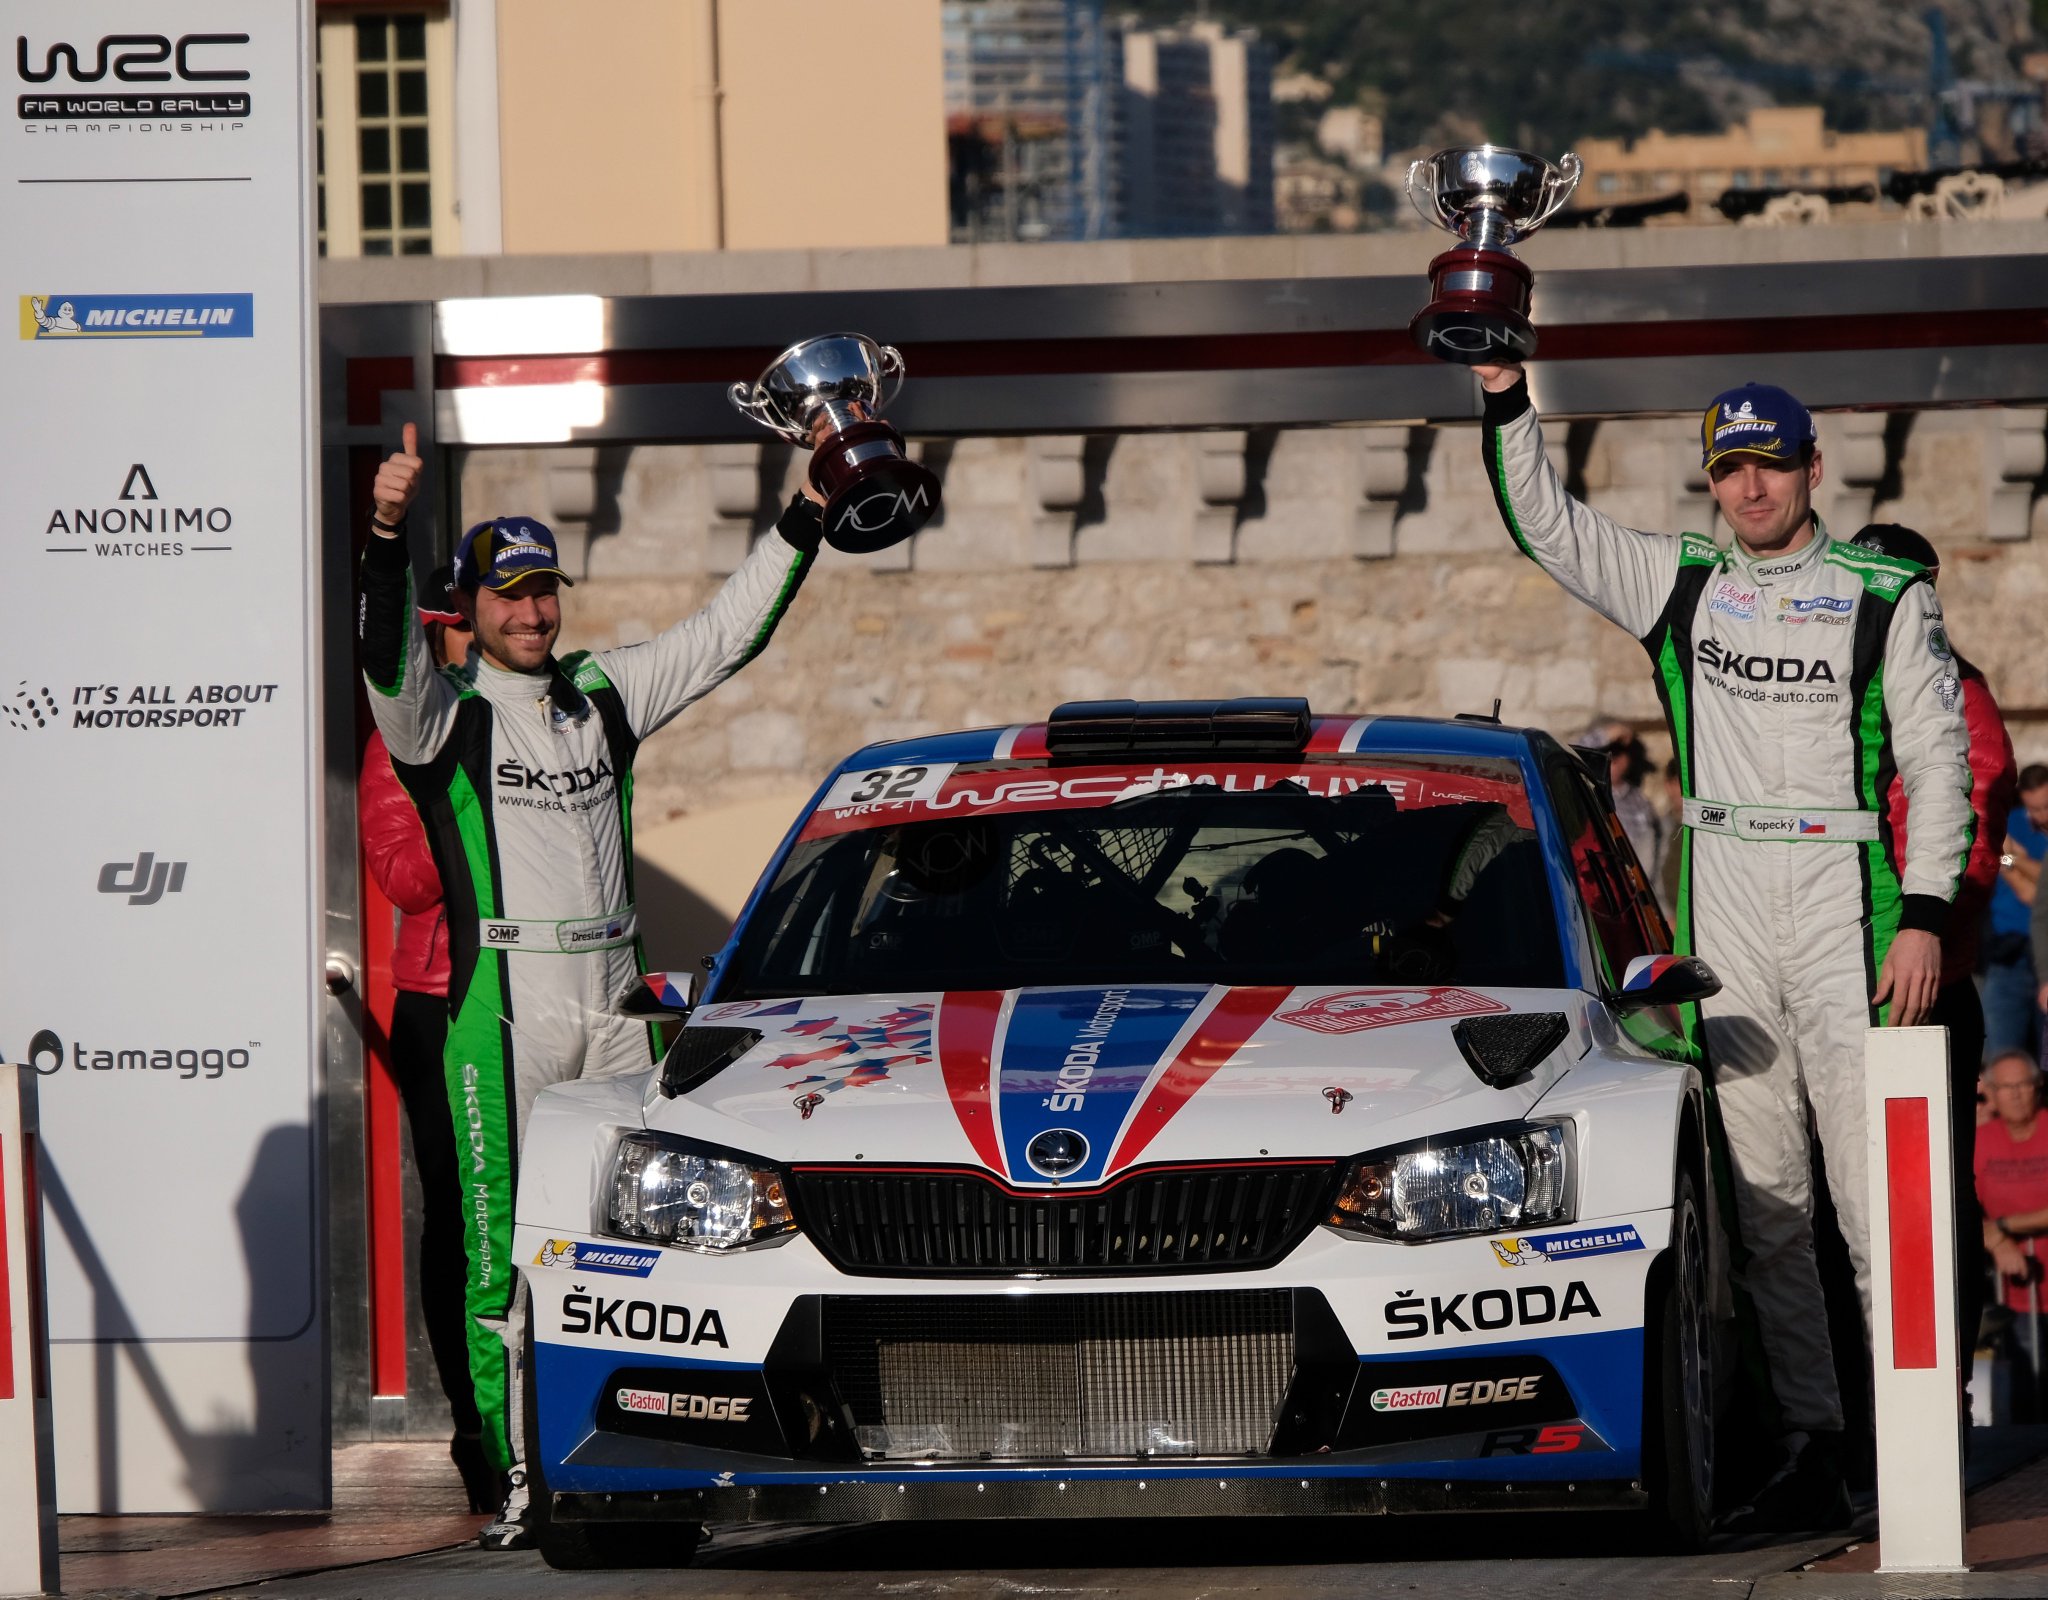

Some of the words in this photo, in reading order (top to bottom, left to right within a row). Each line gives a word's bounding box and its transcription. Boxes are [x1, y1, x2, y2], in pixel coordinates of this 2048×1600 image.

[17, 33, 251, 83] WRC
[24, 101, 59, 113] FIA
[66, 100, 153, 113] WORLD
[160, 99, 244, 112] RALLY
[24, 122, 244, 133] CHAMPIONSHIP
[85, 308, 234, 326] MICHELIN
[1426, 326, 1526, 352] ACM
[1715, 422, 1777, 441] MICHELIN
[834, 483, 930, 533] ACM
[46, 507, 232, 534] ANONIMO
[95, 543, 184, 556] WATCHES
[495, 546, 553, 563] MICHELIN
[1686, 544, 1717, 560] OMP
[1757, 562, 1802, 577] ŠKODA
[1871, 573, 1902, 589] OMP
[1798, 598, 1851, 610] MICHELIN
[1697, 637, 1837, 683] ŠKODA
[72, 684, 118, 705] IT'S
[127, 685, 176, 704] ALL
[185, 684, 278, 703] ABOUT
[72, 708, 246, 728] MOTORSPORT
[497, 758, 616, 797] ŠKODA
[851, 767, 928, 802] 32
[834, 803, 882, 819] WRC
[1701, 808, 1727, 825] OMP
[1749, 818, 1795, 833] Kopecký
[487, 927, 520, 941] OMP
[571, 928, 604, 942] Dresler
[73, 1042, 249, 1079] tamaggo
[1042, 1041, 1105, 1112] ŠKODA
[1076, 990, 1131, 1039] Motorsport
[462, 1063, 486, 1174] ŠKODA
[472, 1184, 492, 1288] Motorsport
[1545, 1230, 1637, 1253] MICHELIN
[580, 1250, 658, 1268] MICHELIN
[561, 1285, 730, 1349] ŠKODA
[1384, 1281, 1602, 1341] ŠKODA
[1388, 1388, 1441, 1409] Castrol
[1447, 1374, 1544, 1407] EDGE
[629, 1392, 666, 1412] Castrol
[670, 1394, 754, 1423] EDGE
[1479, 1425, 1586, 1458] R5
